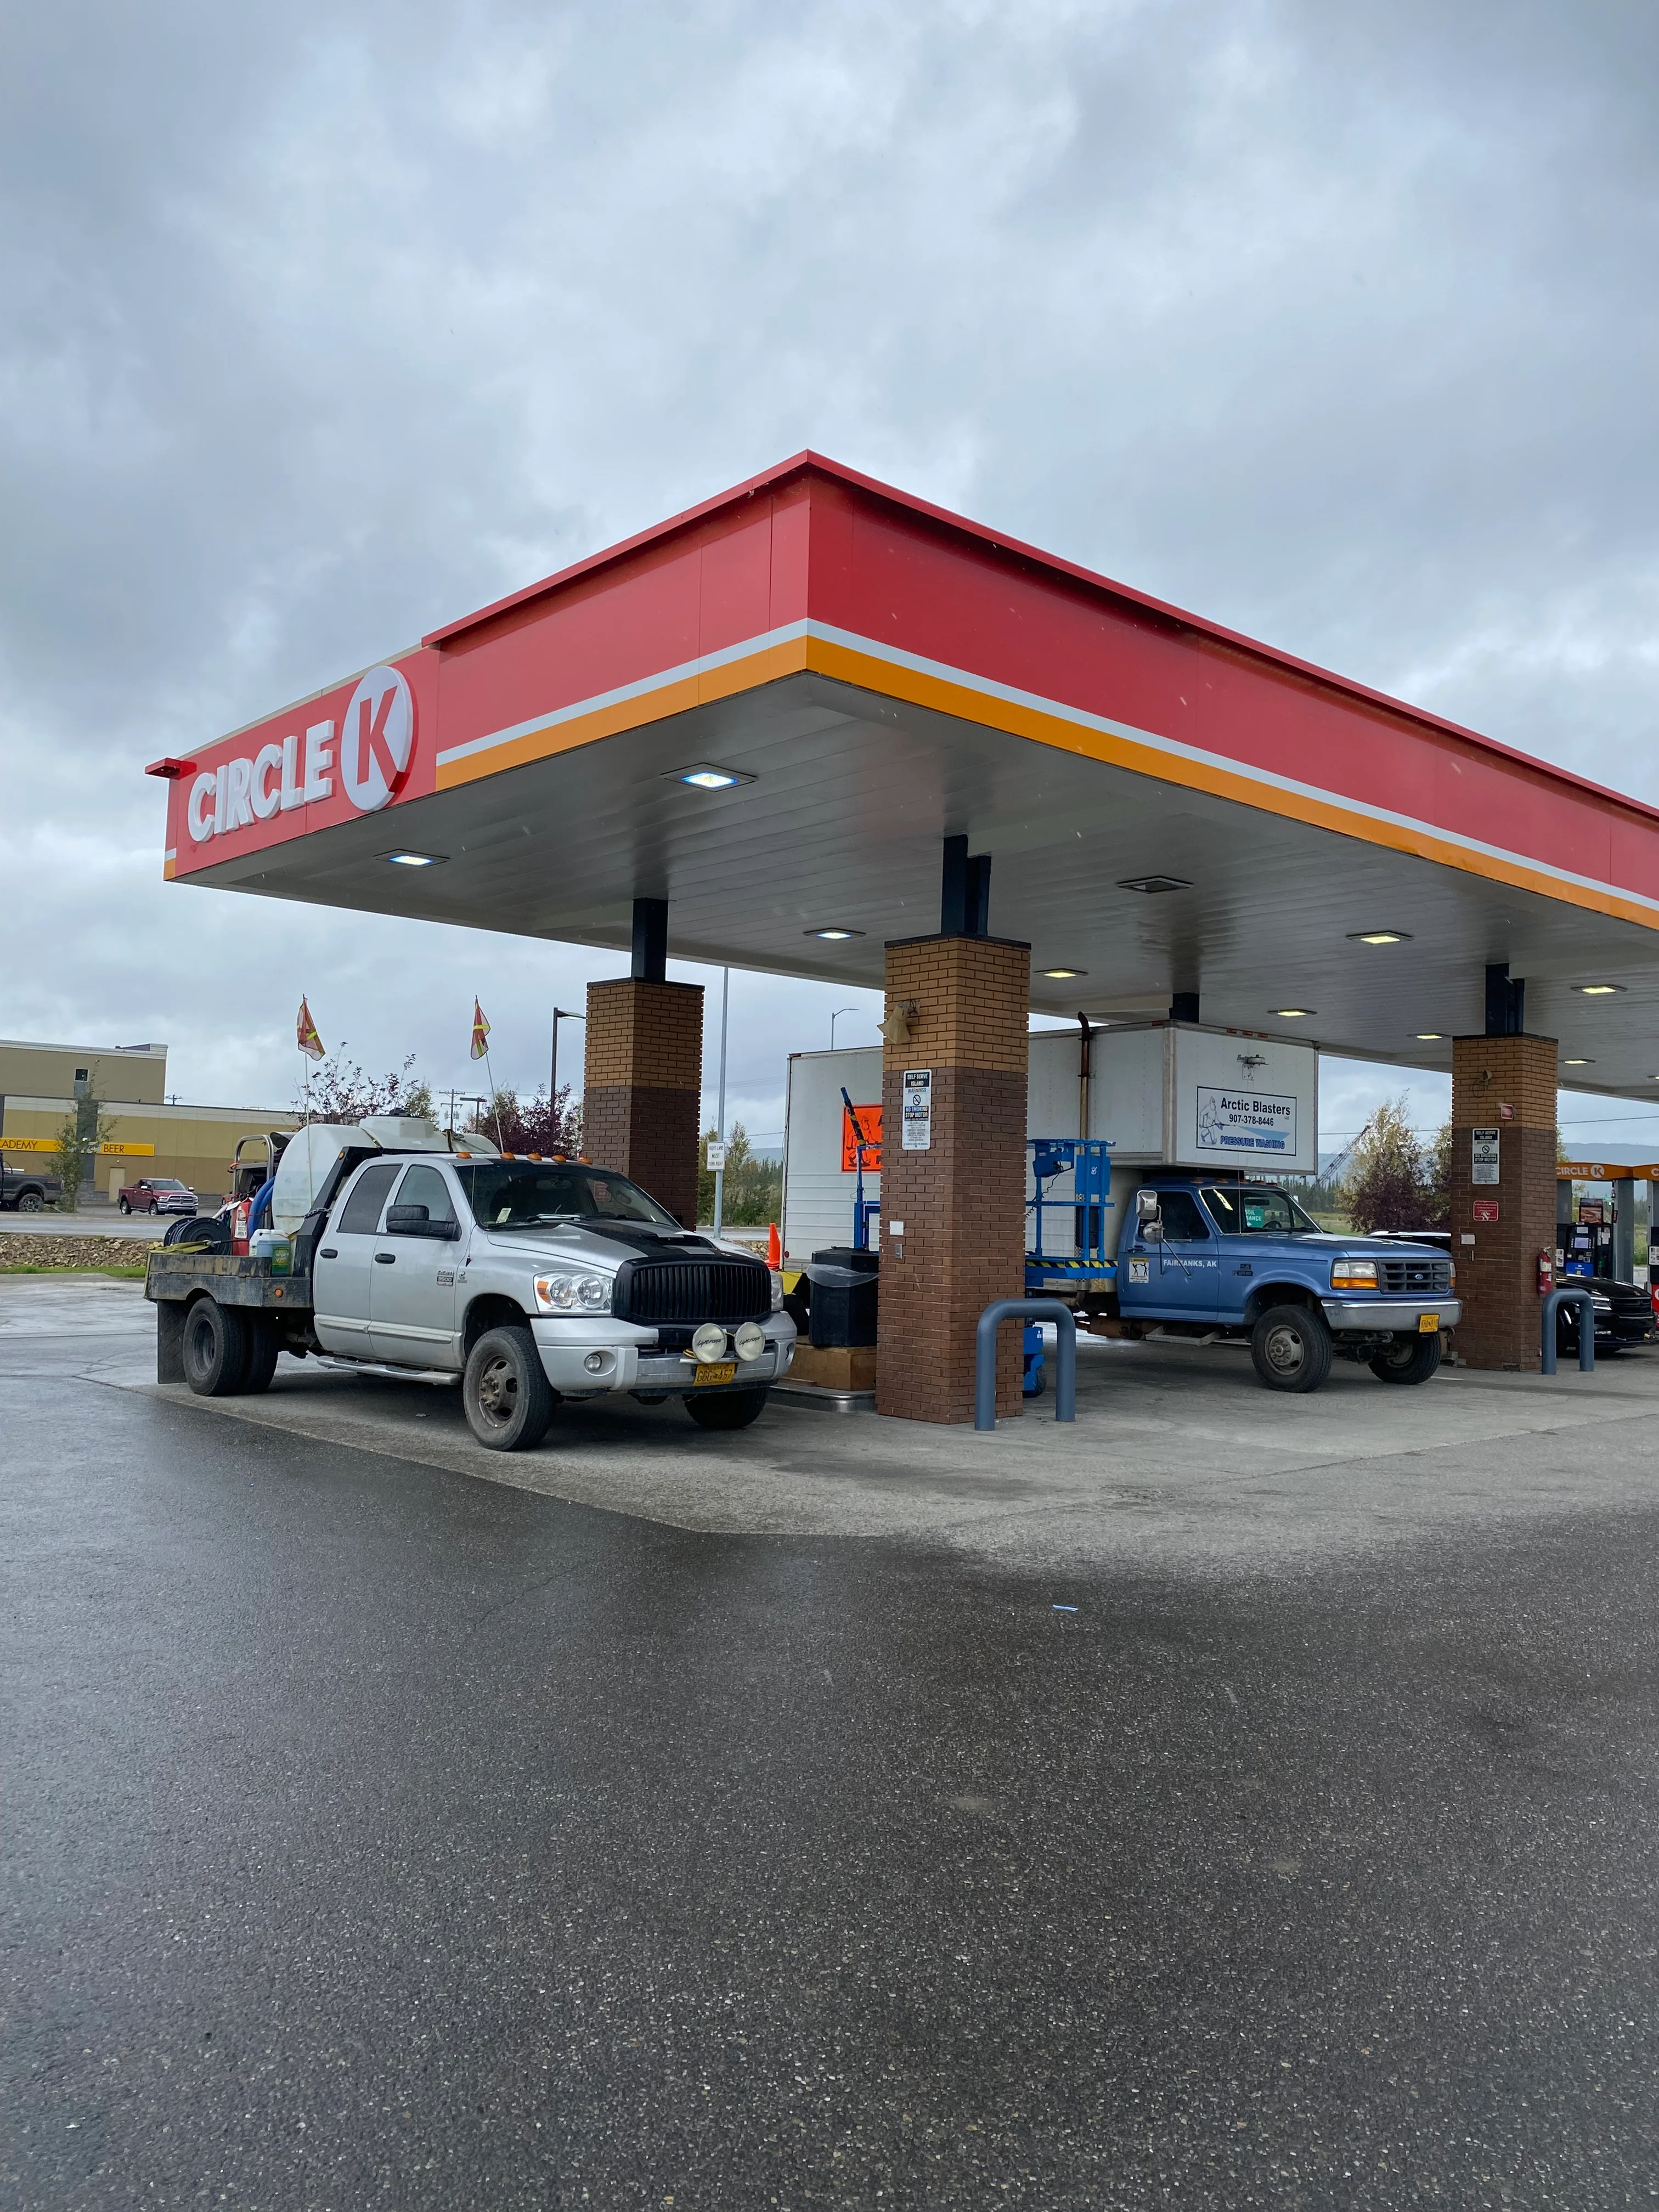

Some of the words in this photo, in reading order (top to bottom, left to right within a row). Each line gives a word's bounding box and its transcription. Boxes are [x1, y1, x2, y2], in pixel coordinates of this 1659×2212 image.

[188, 720, 335, 843] CIRCLE
[354, 682, 413, 795] K
[1221, 1097, 1250, 1111] Arctic
[1253, 1101, 1290, 1115] Blasters
[1229, 1114, 1274, 1126] 907-378-8446
[0, 1139, 37, 1150] ADEMY
[104, 1144, 124, 1153] BEER
[1220, 1136, 1254, 1147] PRESSURE
[1255, 1138, 1285, 1149] WASHING
[1593, 1166, 1603, 1178] K
[718, 1369, 732, 1381] 457
